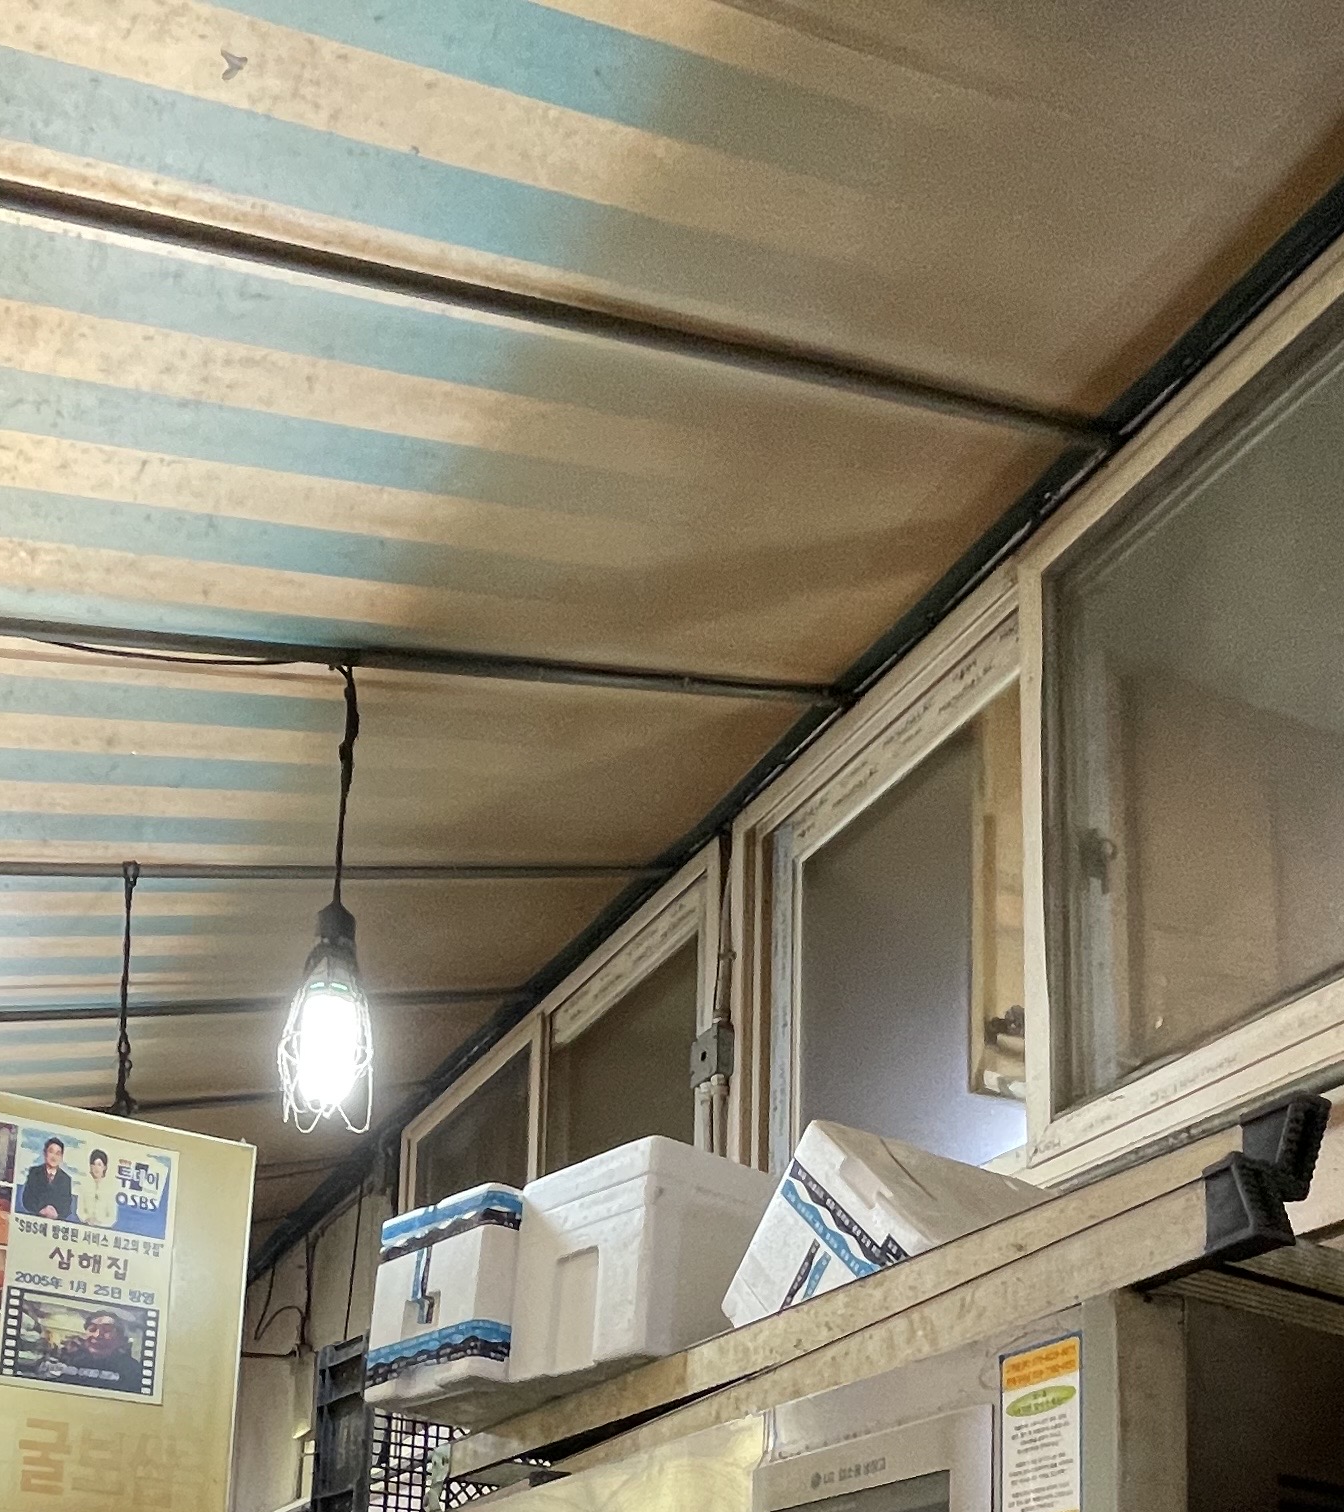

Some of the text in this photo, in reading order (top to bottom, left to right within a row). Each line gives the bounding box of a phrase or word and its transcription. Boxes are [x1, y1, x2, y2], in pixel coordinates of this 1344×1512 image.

[115, 1161, 160, 1192] 투데이
[130, 1194, 157, 1212] SBS
[52, 1224, 80, 1243] 방영된
[83, 1232, 109, 1248] 서비스
[113, 1236, 140, 1253] 최고의
[49, 1246, 129, 1281] 삼해집
[15, 1271, 63, 1290] 2005年
[69, 1279, 87, 1294] 1月
[94, 1284, 122, 1300] 25日
